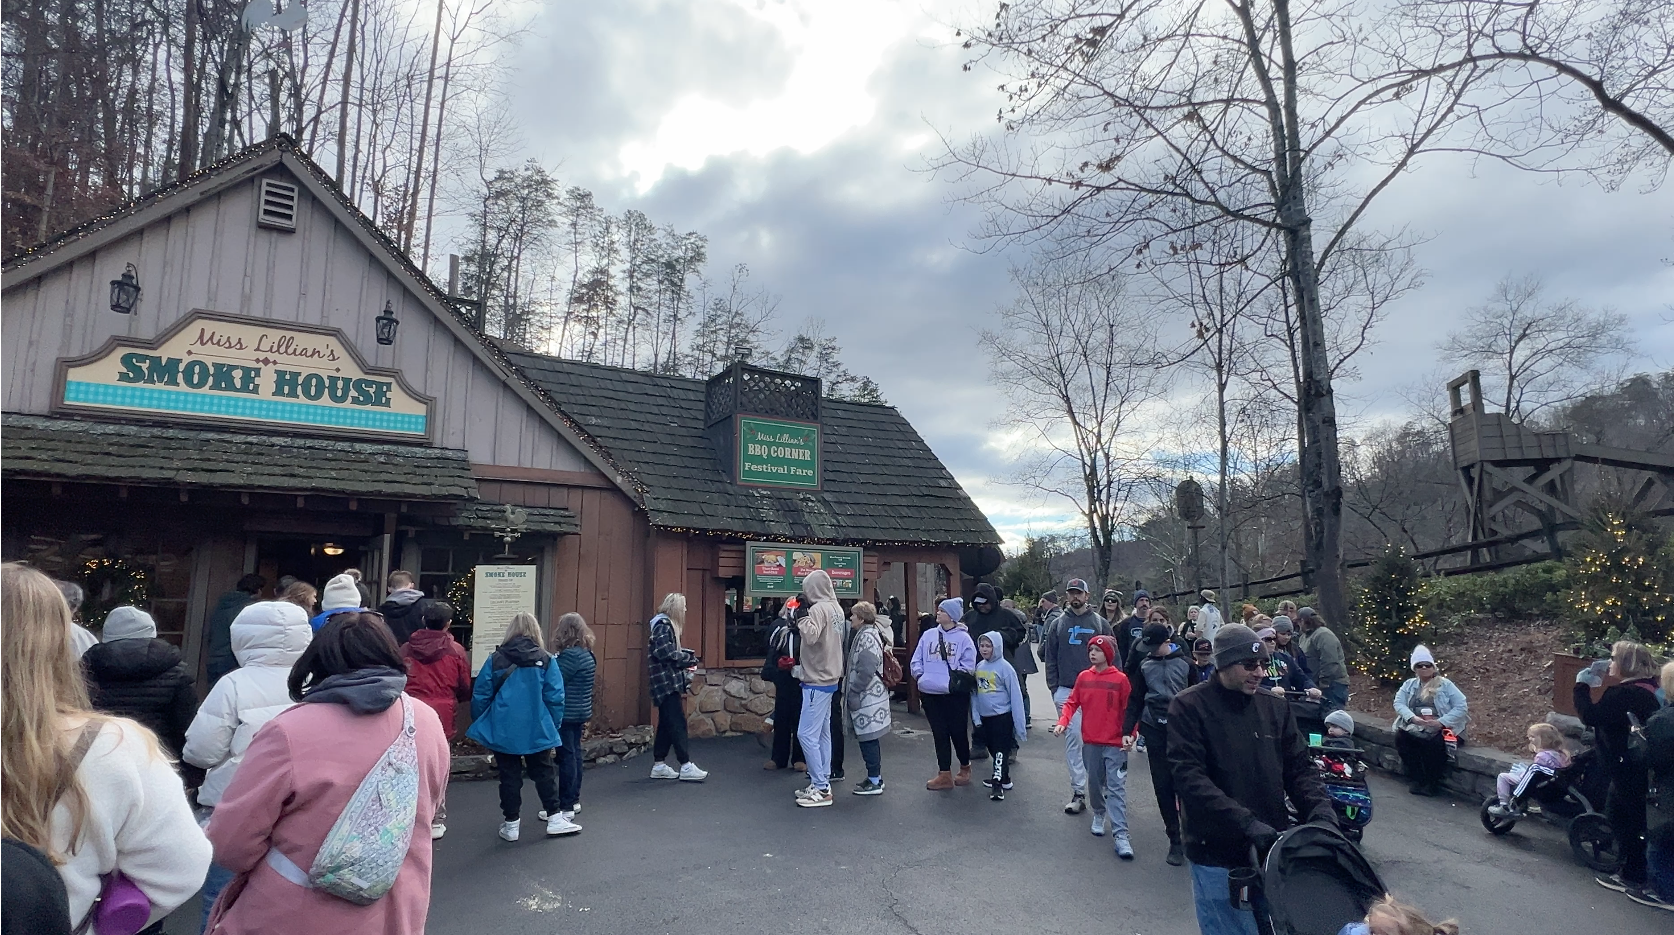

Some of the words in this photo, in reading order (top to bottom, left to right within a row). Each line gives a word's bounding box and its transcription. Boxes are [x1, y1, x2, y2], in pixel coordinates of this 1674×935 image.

[189, 327, 248, 351] Miss
[253, 334, 341, 362] Lillian's
[116, 352, 260, 395] SMOKE
[272, 368, 393, 408] HOUSE
[756, 431, 774, 442] Miss
[747, 443, 769, 459] BBQ
[770, 445, 811, 461] CORNER
[744, 462, 788, 474] Festival
[790, 466, 814, 476] Fare
